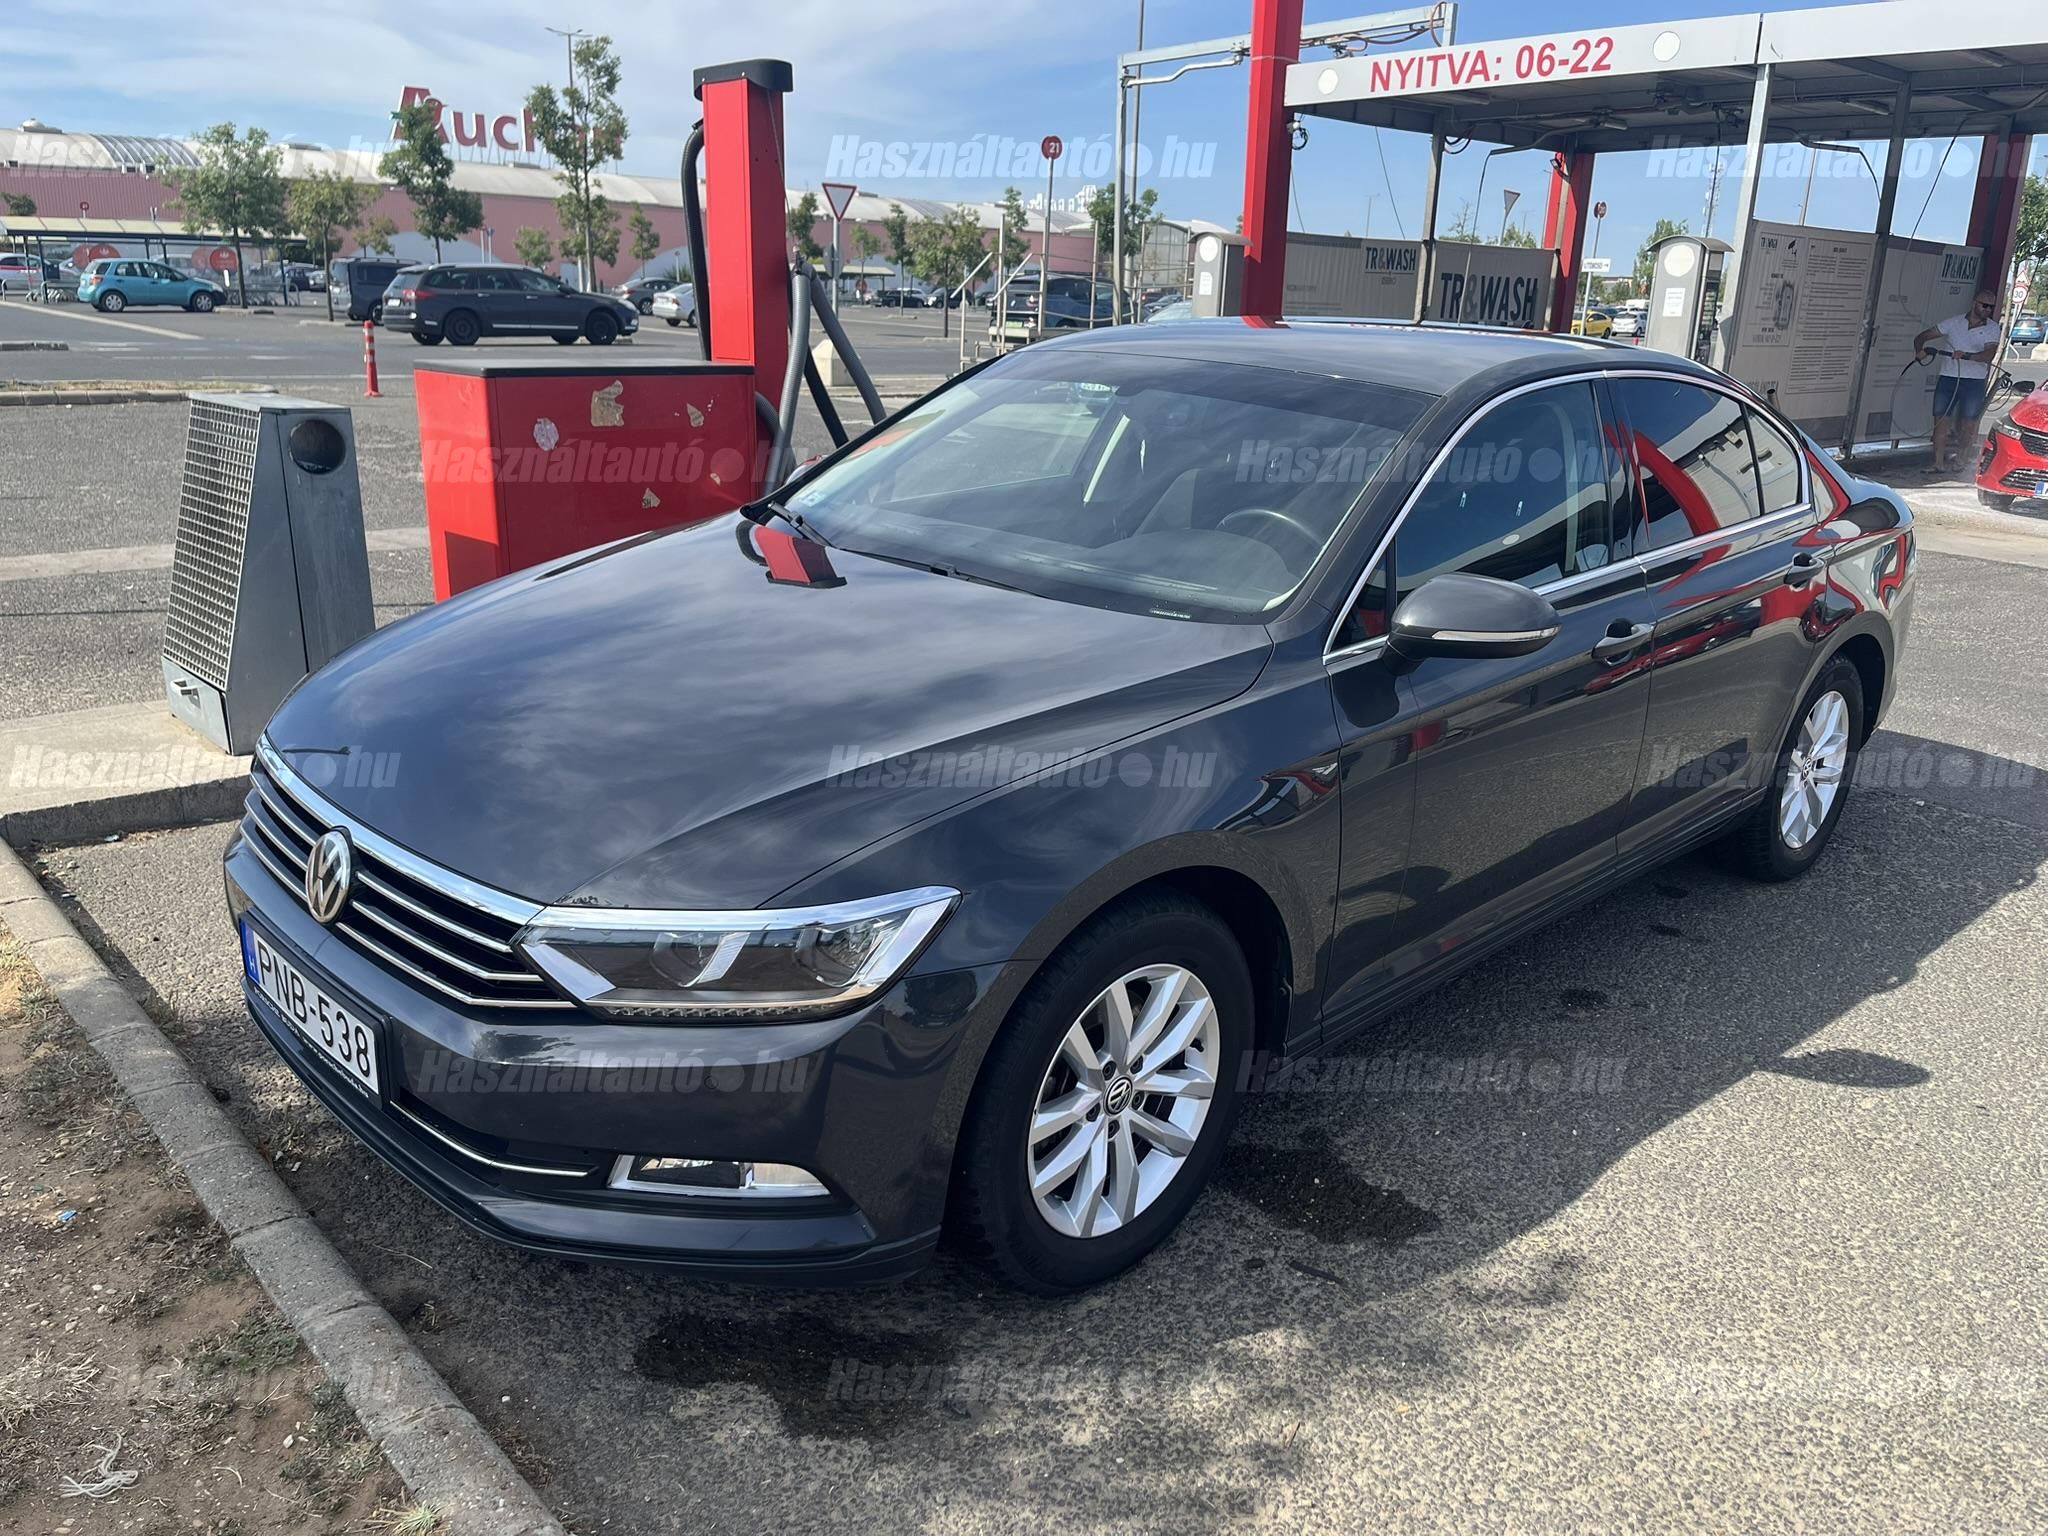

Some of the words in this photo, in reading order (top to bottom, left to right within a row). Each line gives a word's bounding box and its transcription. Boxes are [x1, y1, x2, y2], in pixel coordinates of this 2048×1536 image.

[1370, 49, 1502, 93] NYITVA:
[1514, 36, 1614, 80] 06-22
[390, 85, 624, 161] Auch
[1049, 142, 1060, 154] 21
[1365, 246, 1417, 272] TR&WASH
[1440, 272, 1539, 322] TR&WASH
[2013, 291, 2024, 299] 30
[256, 939, 371, 1079] PNB-538
